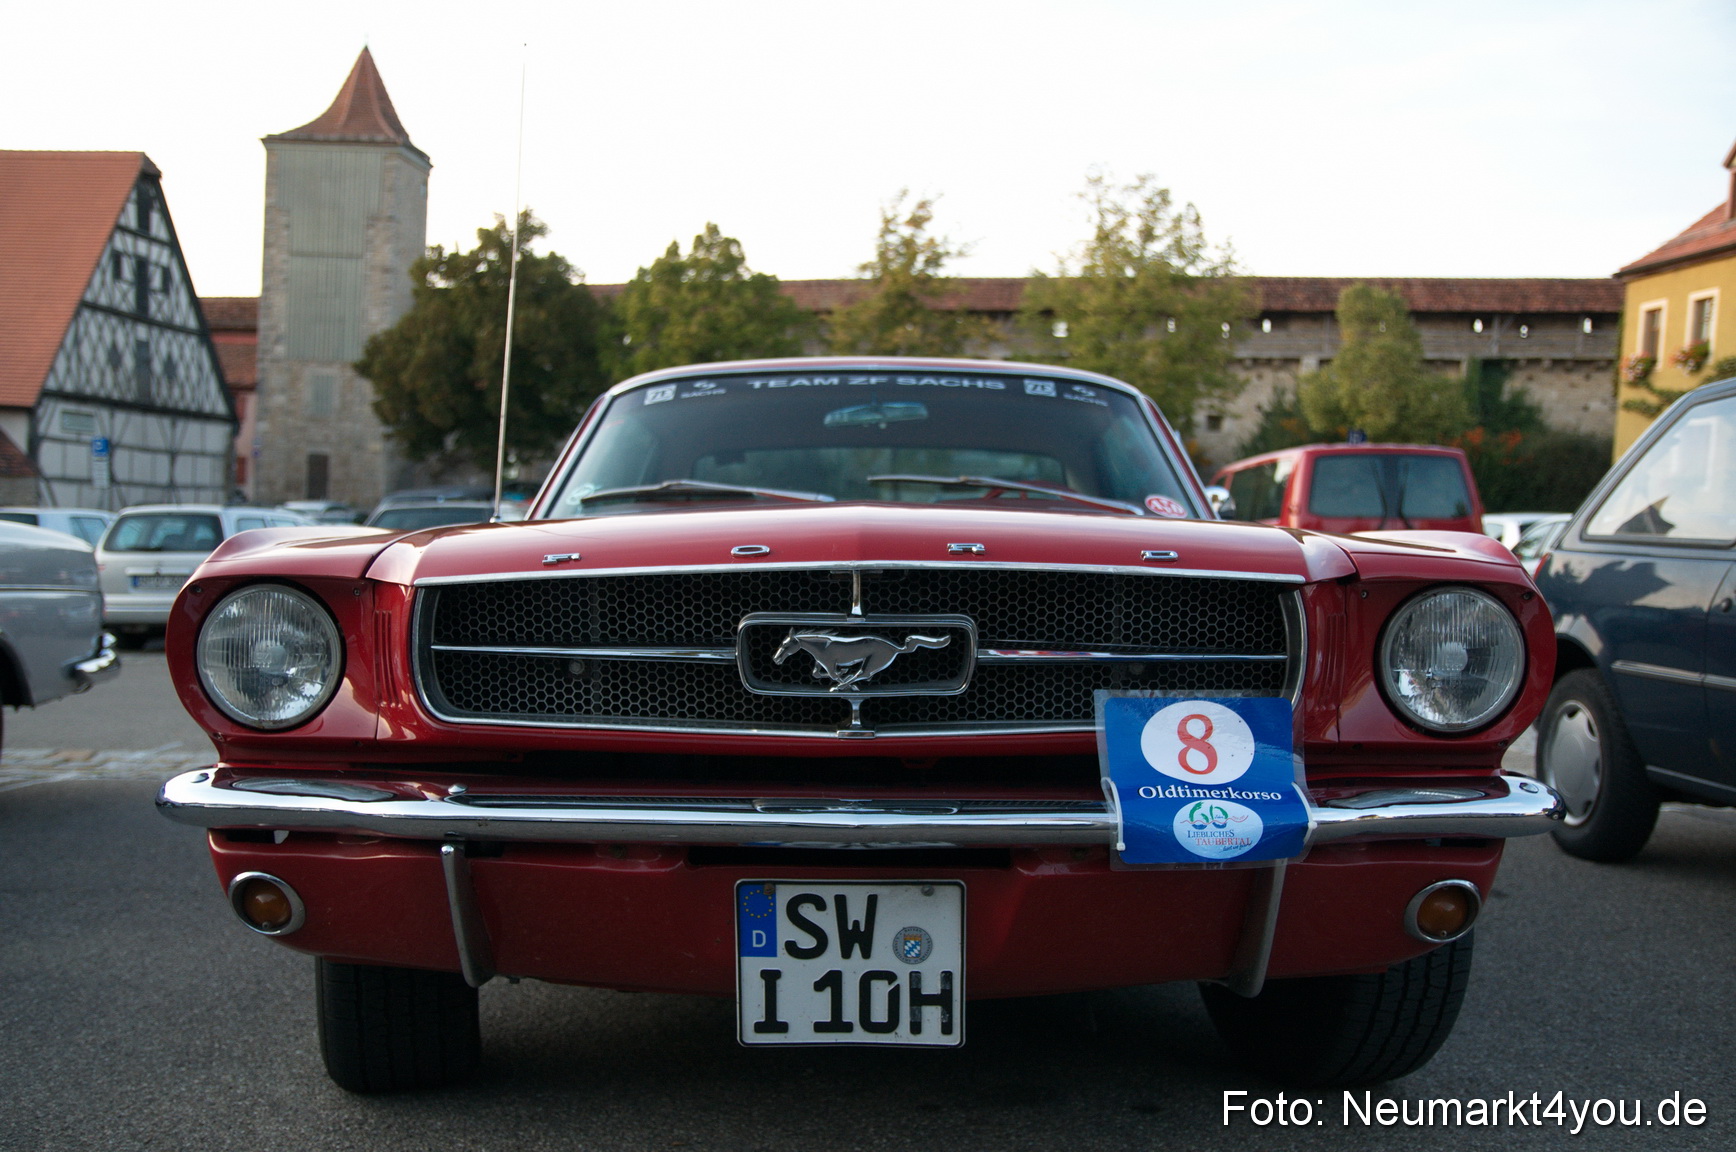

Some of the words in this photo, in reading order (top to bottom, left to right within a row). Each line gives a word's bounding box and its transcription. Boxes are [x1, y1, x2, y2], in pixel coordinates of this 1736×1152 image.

[750, 377, 839, 389] TEAM
[848, 377, 888, 386] ZF
[896, 377, 1006, 390] SACHS
[1177, 714, 1218, 775] 8
[1138, 784, 1282, 801] Oldtimerkorso
[1195, 837, 1252, 846] TAUBERTAL
[784, 893, 878, 960] SW
[752, 930, 767, 948] D
[813, 969, 953, 1036] 10H
